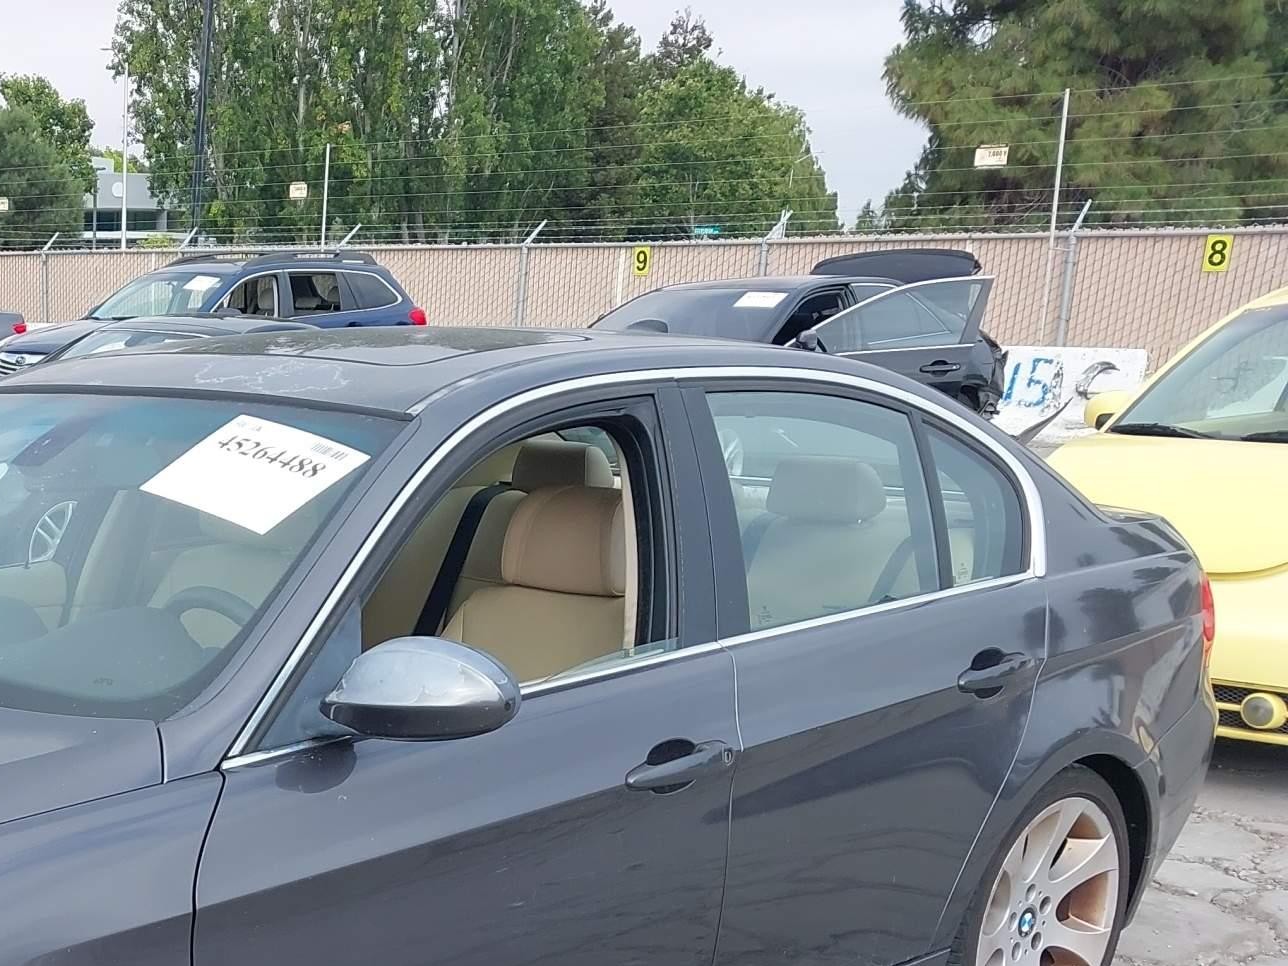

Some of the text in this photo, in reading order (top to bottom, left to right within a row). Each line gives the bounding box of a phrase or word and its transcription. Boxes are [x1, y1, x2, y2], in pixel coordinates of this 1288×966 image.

[636, 250, 648, 271] 9
[1208, 239, 1227, 266] 8
[218, 435, 326, 478] 45264488
